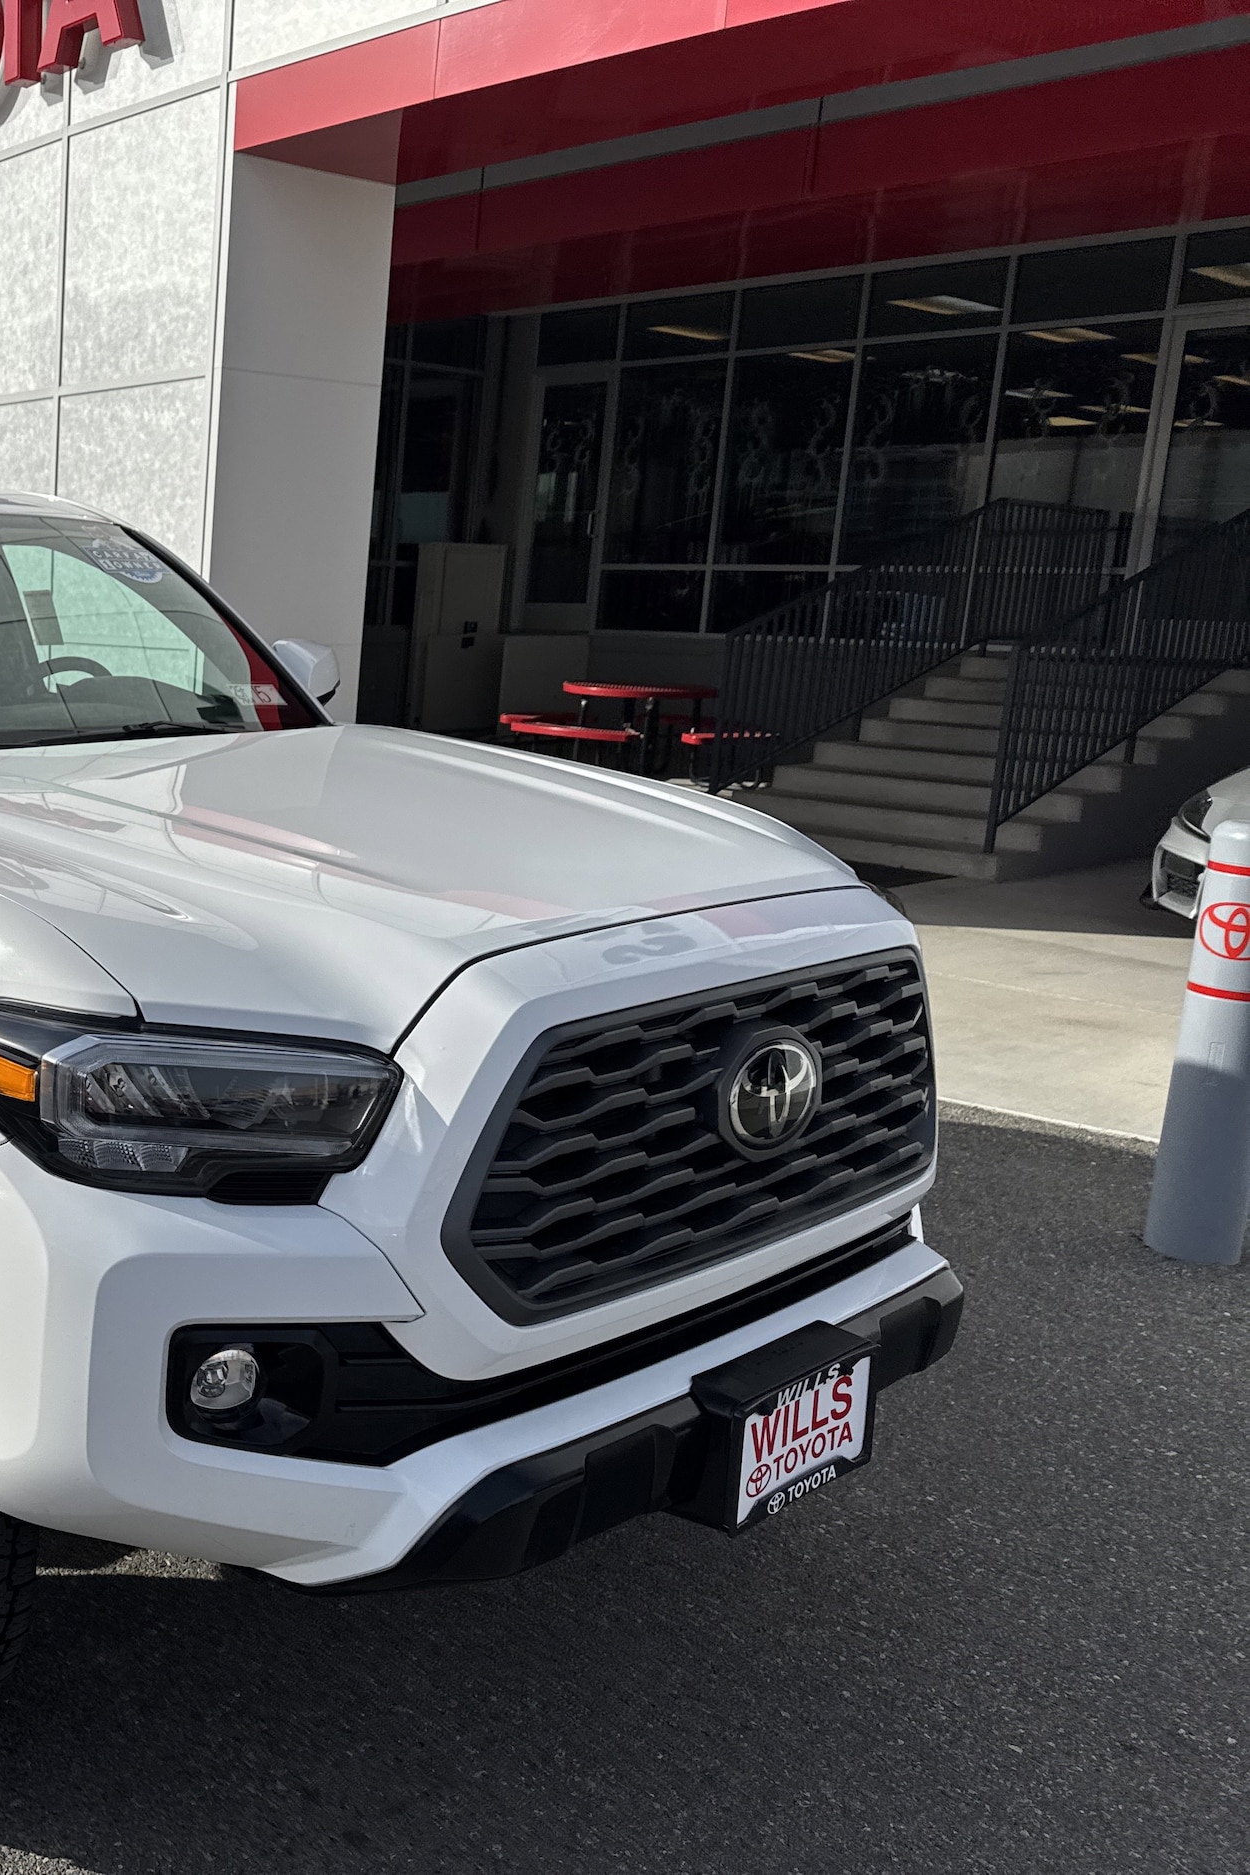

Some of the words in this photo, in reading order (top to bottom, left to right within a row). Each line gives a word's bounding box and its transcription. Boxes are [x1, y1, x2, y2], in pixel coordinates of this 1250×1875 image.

[777, 1363, 841, 1409] WILLS
[751, 1375, 853, 1464] WILLS
[773, 1421, 853, 1480] TOYOTA
[787, 1465, 837, 1502] TOYOTA
